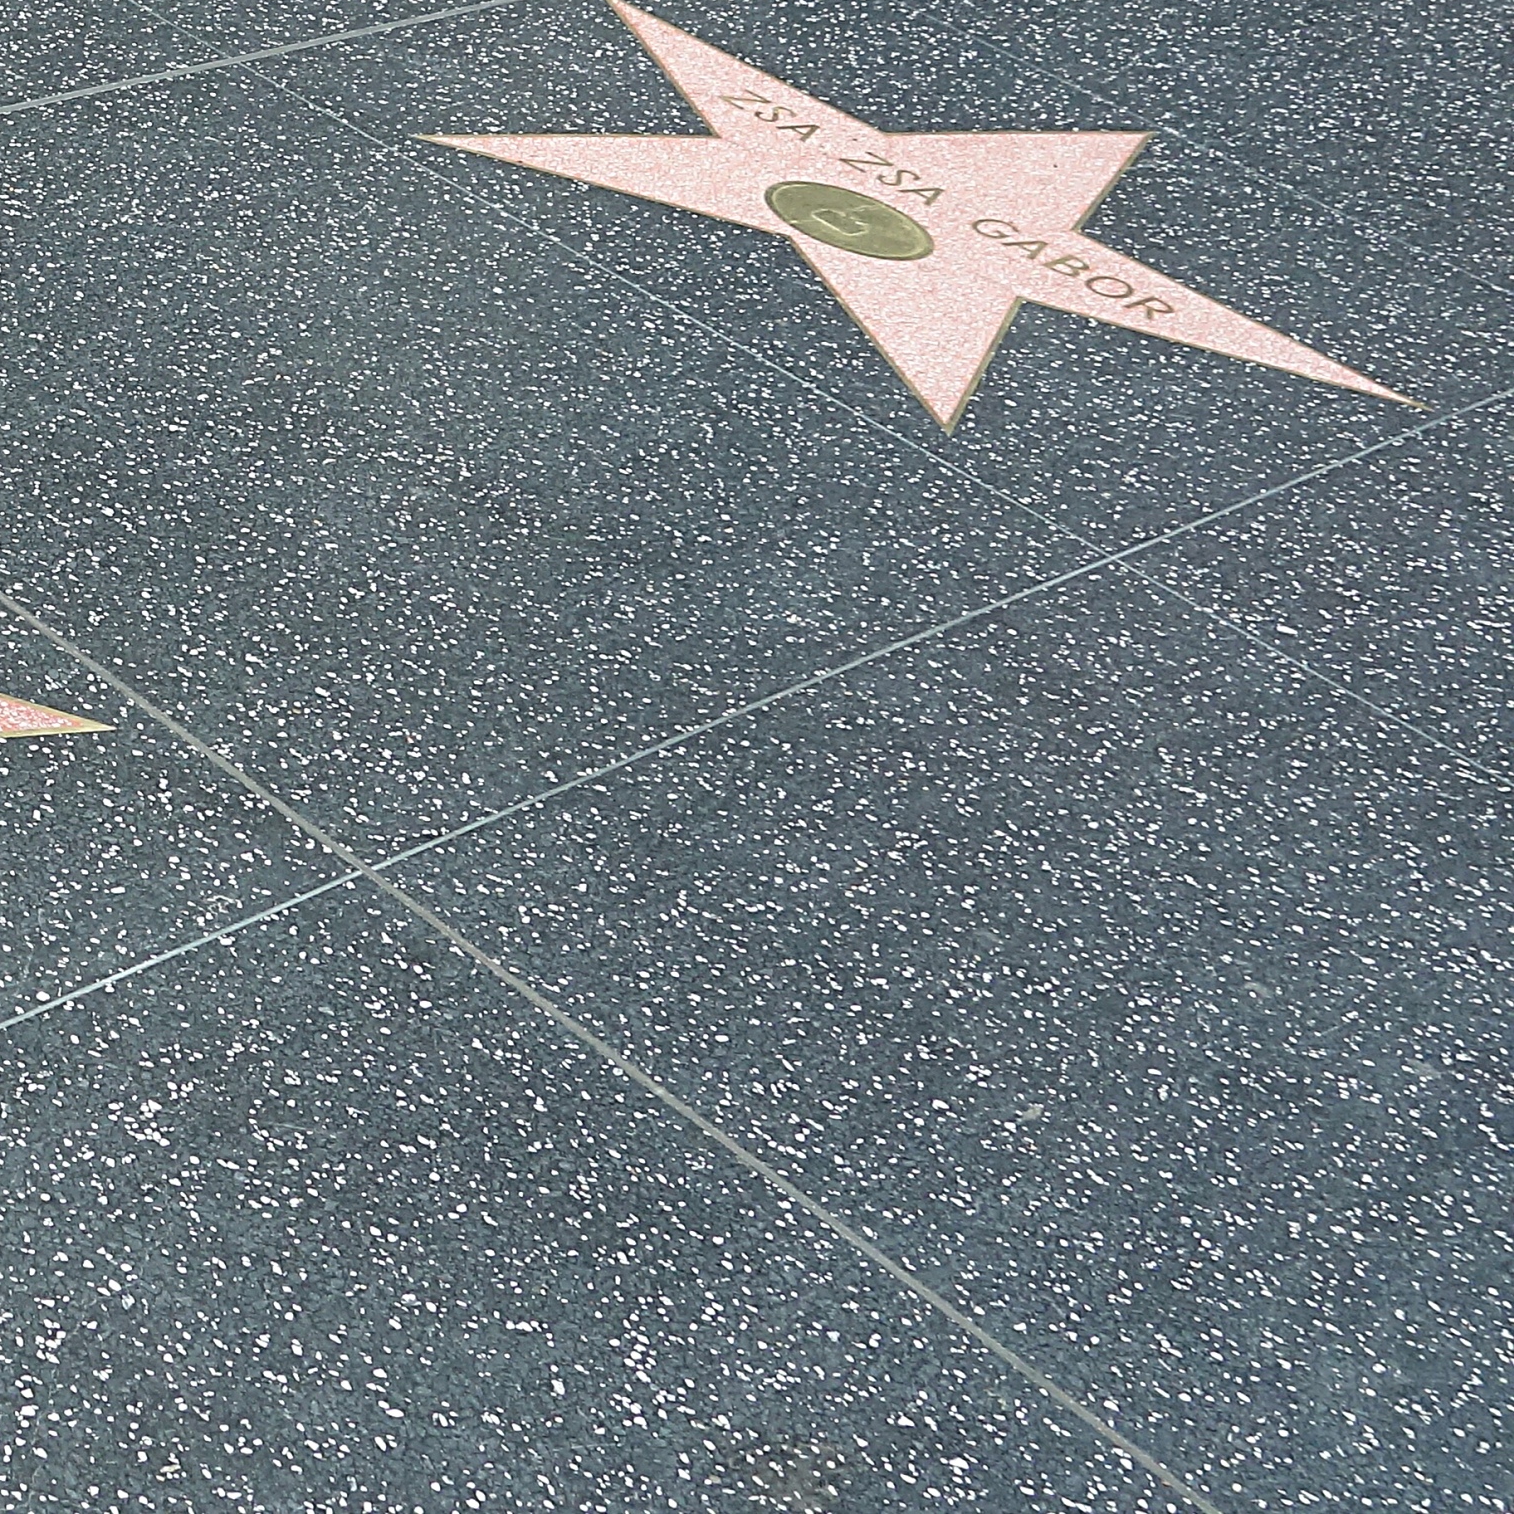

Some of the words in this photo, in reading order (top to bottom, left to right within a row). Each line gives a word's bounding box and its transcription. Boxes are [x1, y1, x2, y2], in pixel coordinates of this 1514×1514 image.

[718, 89, 822, 143] ZSA
[838, 150, 948, 206] ZSA
[972, 217, 1175, 322] GABOR
